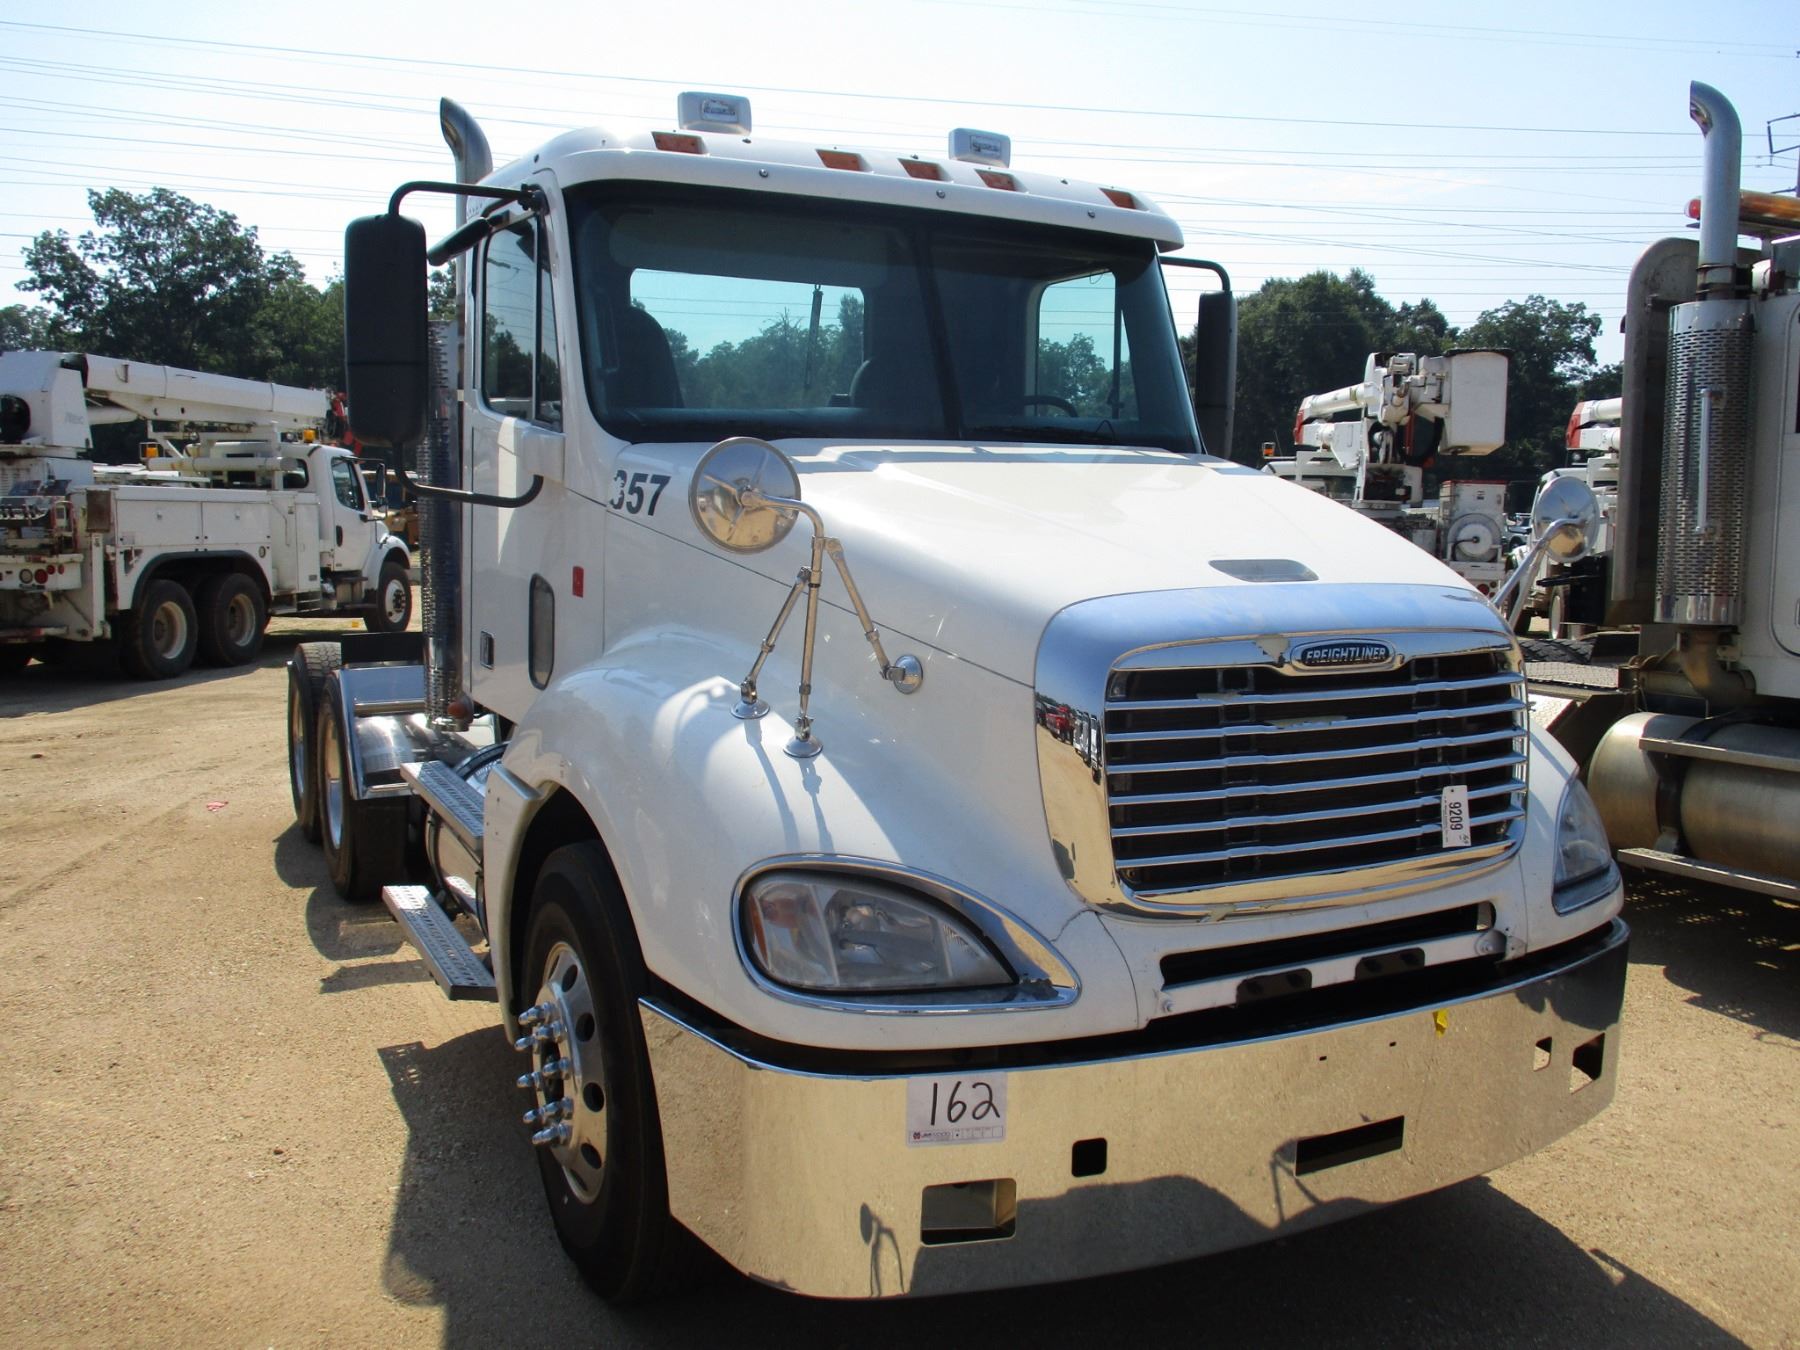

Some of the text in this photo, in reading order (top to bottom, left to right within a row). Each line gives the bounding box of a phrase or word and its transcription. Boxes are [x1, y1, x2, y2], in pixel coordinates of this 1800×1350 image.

[609, 469, 671, 516] 357
[1306, 645, 1387, 663] FREIGHTLINER
[1448, 802, 1464, 831] 9209
[930, 1081, 1001, 1126] 162
